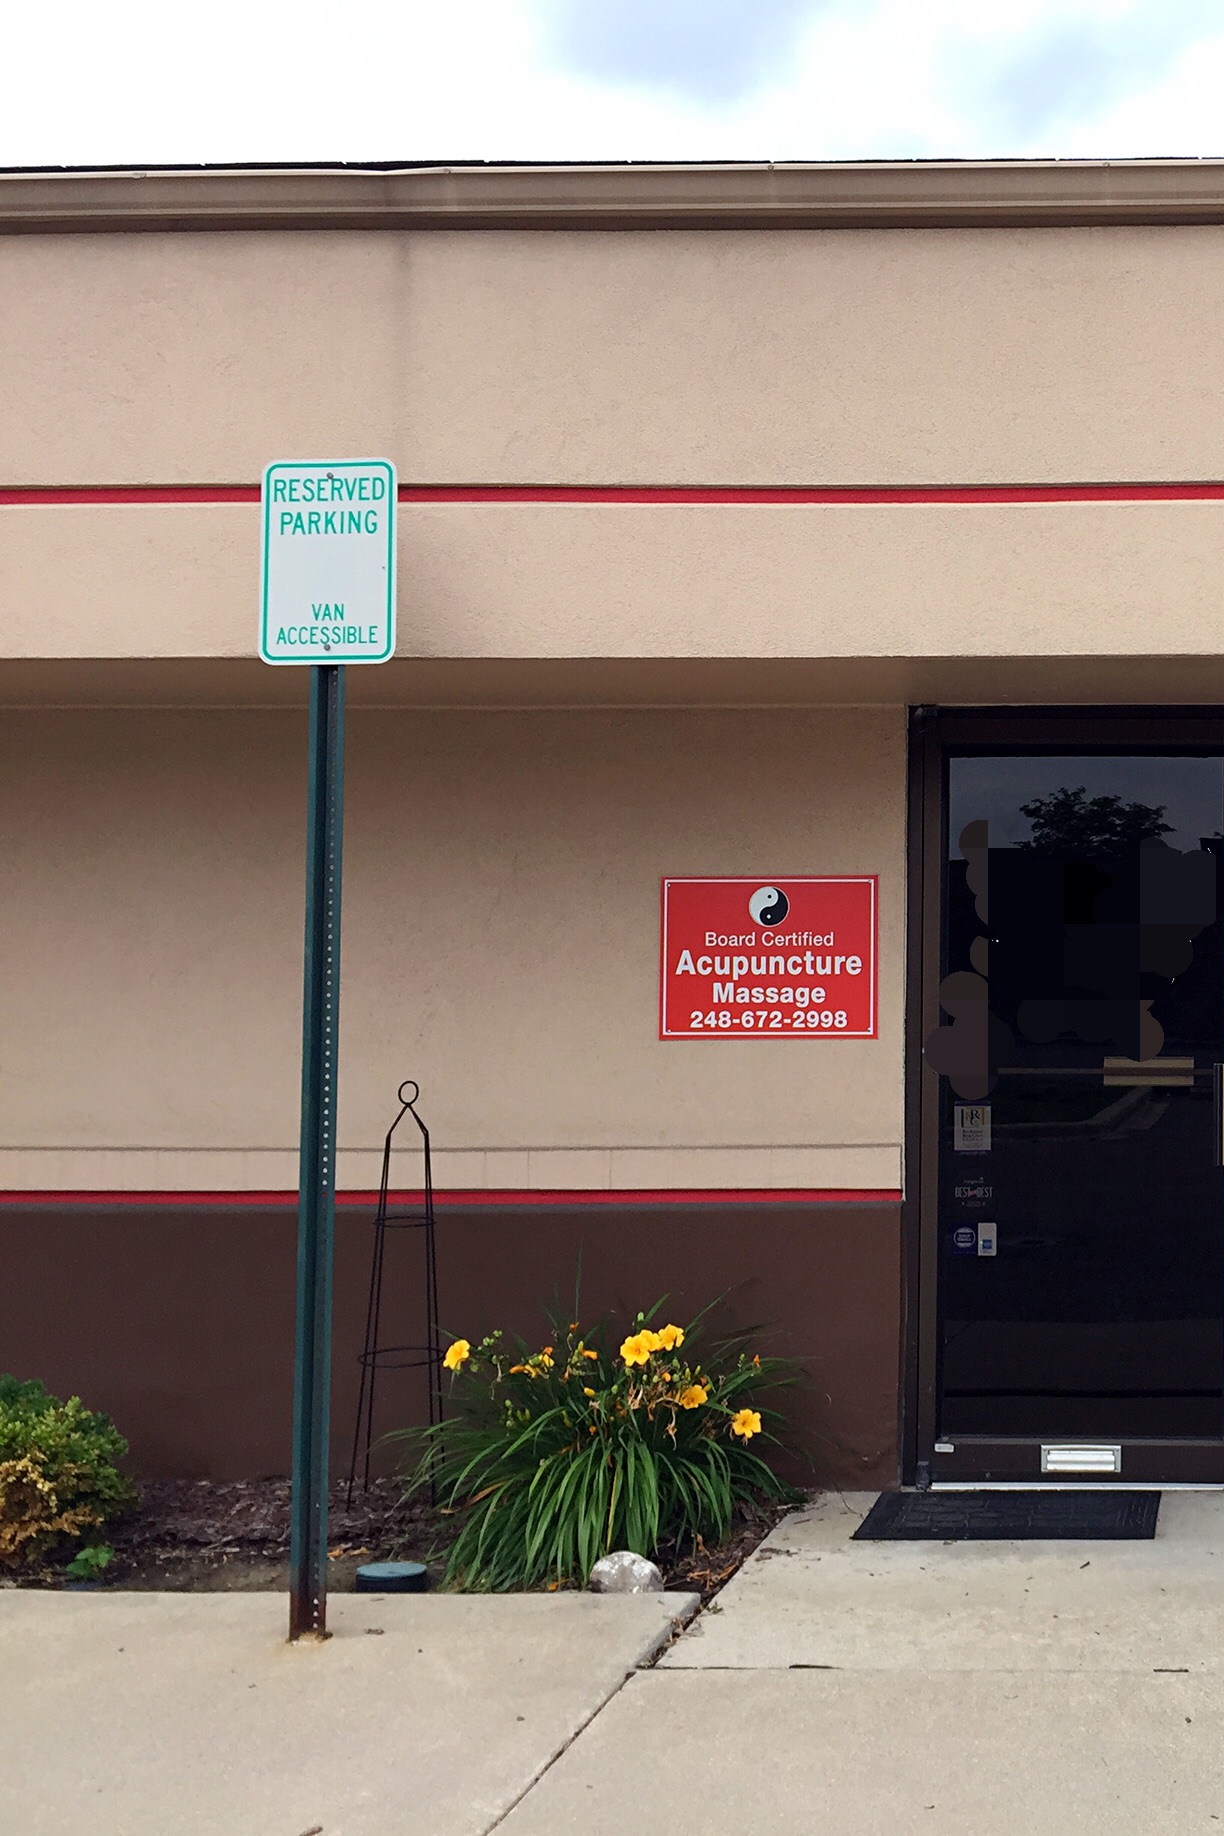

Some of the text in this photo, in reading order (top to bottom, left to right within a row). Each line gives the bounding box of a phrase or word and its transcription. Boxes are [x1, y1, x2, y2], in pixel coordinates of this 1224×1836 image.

[274, 477, 385, 502] RESERVED
[280, 510, 378, 535] PARKING
[311, 603, 344, 621] VAN
[276, 625, 378, 645] ACCESSIBLE
[705, 931, 834, 947] Board Certified
[675, 949, 862, 981] Acupuncture
[712, 982, 826, 1008] Massage
[690, 1010, 848, 1028] 248-672-2998
